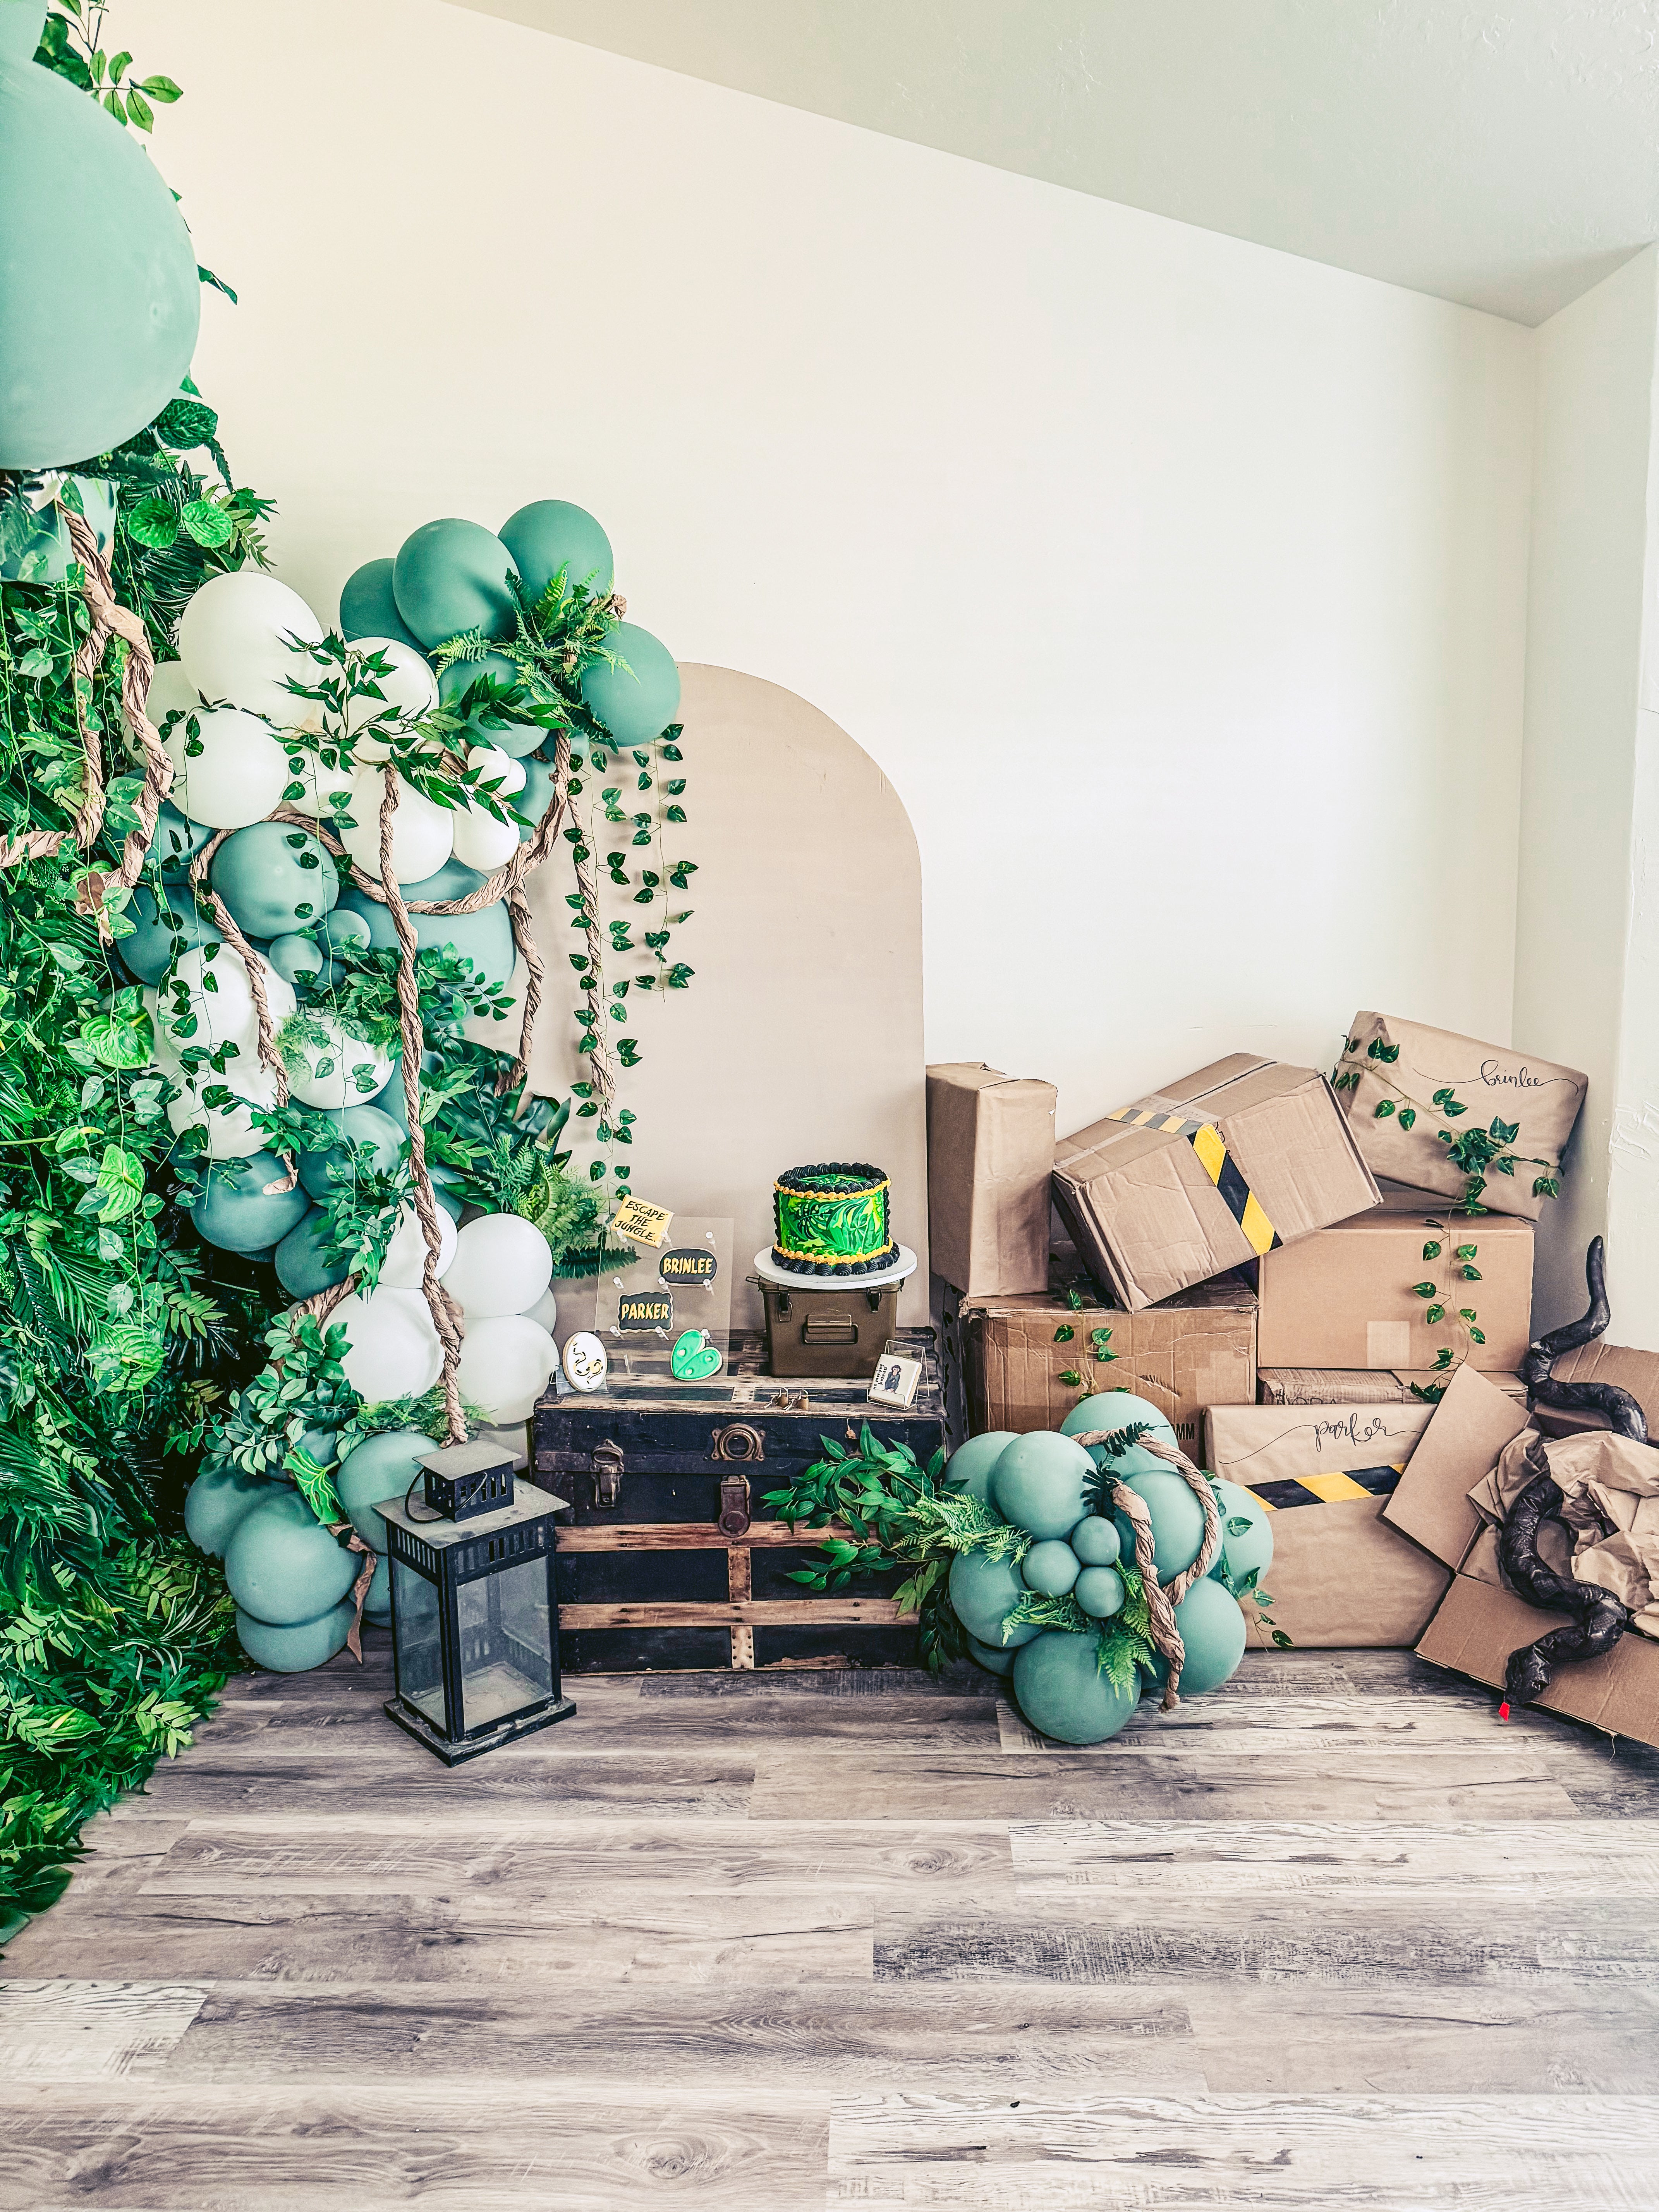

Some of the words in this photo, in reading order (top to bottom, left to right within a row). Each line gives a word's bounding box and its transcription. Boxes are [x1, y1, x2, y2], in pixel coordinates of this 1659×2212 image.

[625, 1200, 668, 1220] ESCAPE
[629, 1214, 653, 1226] THE
[615, 1221, 656, 1242] JUNGLE.
[663, 1257, 714, 1274] BRINLEE
[621, 1303, 669, 1320] PARKER
[1313, 1413, 1388, 1452] parker
